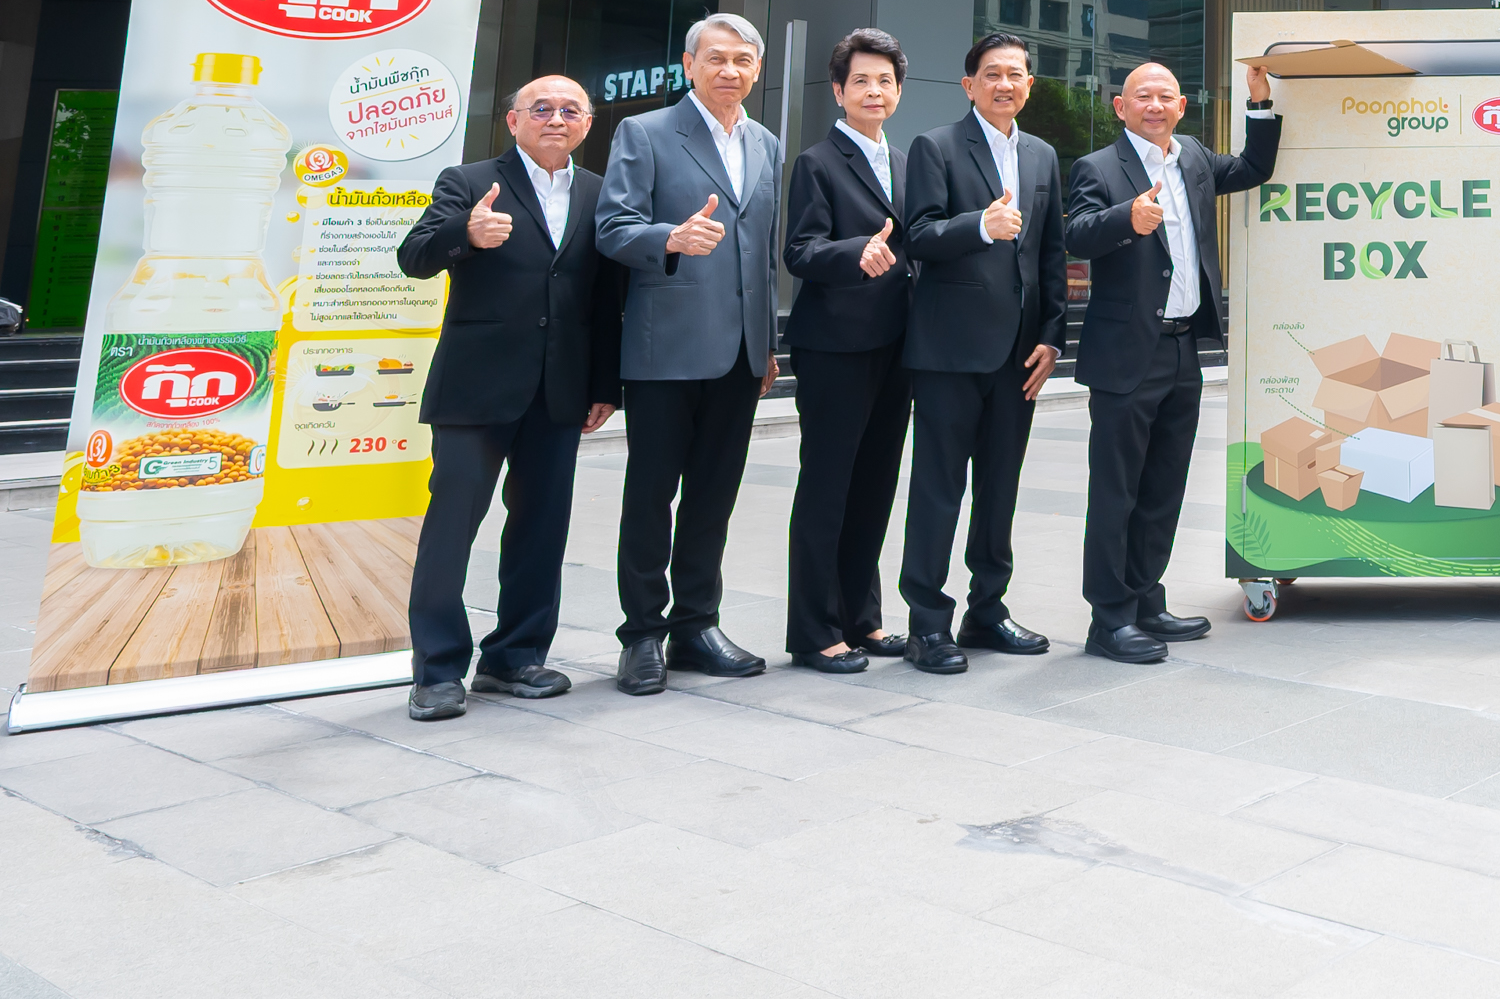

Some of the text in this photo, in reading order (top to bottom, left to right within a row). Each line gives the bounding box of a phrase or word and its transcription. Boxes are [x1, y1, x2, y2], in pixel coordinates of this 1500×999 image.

[319, 7, 372, 23] COOK
[350, 66, 429, 94] น้ำมันพืชกุ๊ก
[348, 86, 446, 124] ปลอดภัย
[346, 105, 453, 140] จากไขมันทรานส์
[1387, 116, 1449, 138] group
[1259, 179, 1492, 222] RECYCLE
[1323, 241, 1428, 280] BOX
[110, 346, 133, 357] ตรา
[188, 397, 219, 407] COOK
[349, 437, 387, 453] 230
[208, 456, 217, 470] 5
